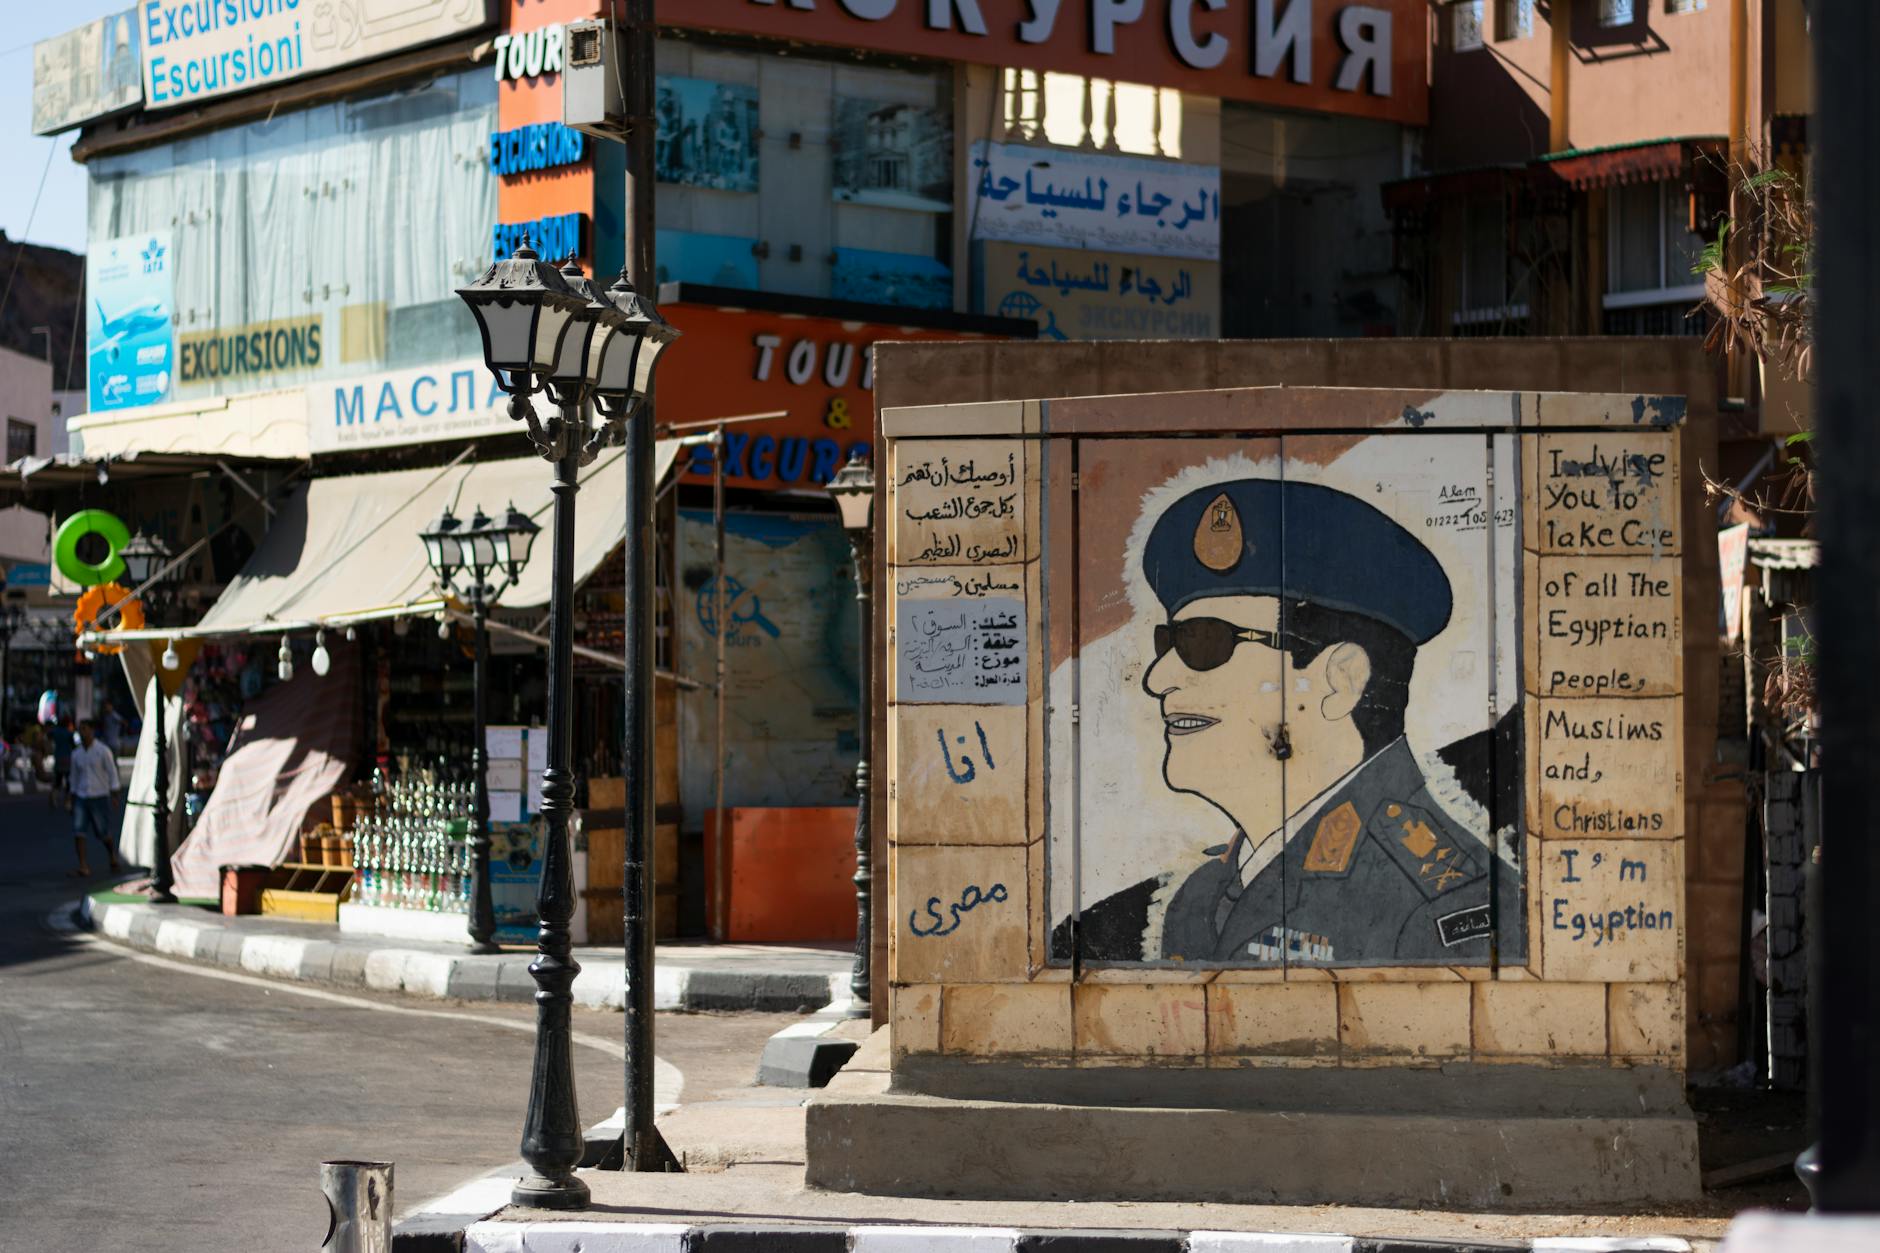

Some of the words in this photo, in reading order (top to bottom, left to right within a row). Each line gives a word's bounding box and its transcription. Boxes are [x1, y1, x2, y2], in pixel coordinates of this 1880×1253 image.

[151, 22, 302, 102] Escursioni
[494, 25, 566, 82] TOUR
[490, 121, 583, 176] EXCURSIONS
[973, 158, 1108, 219] للسياحة
[1117, 181, 1218, 230] الرجاء
[1017, 252, 1109, 296] للسياحة
[180, 324, 321, 382] EXCURSIONS
[827, 398, 851, 429] &
[906, 496, 963, 527] الشعب
[1585, 573, 1617, 597] all
[1628, 572, 1671, 597] The
[1549, 610, 1666, 646] Egyptian
[1545, 710, 1662, 740] Muslims
[1554, 804, 1662, 833] Christians
